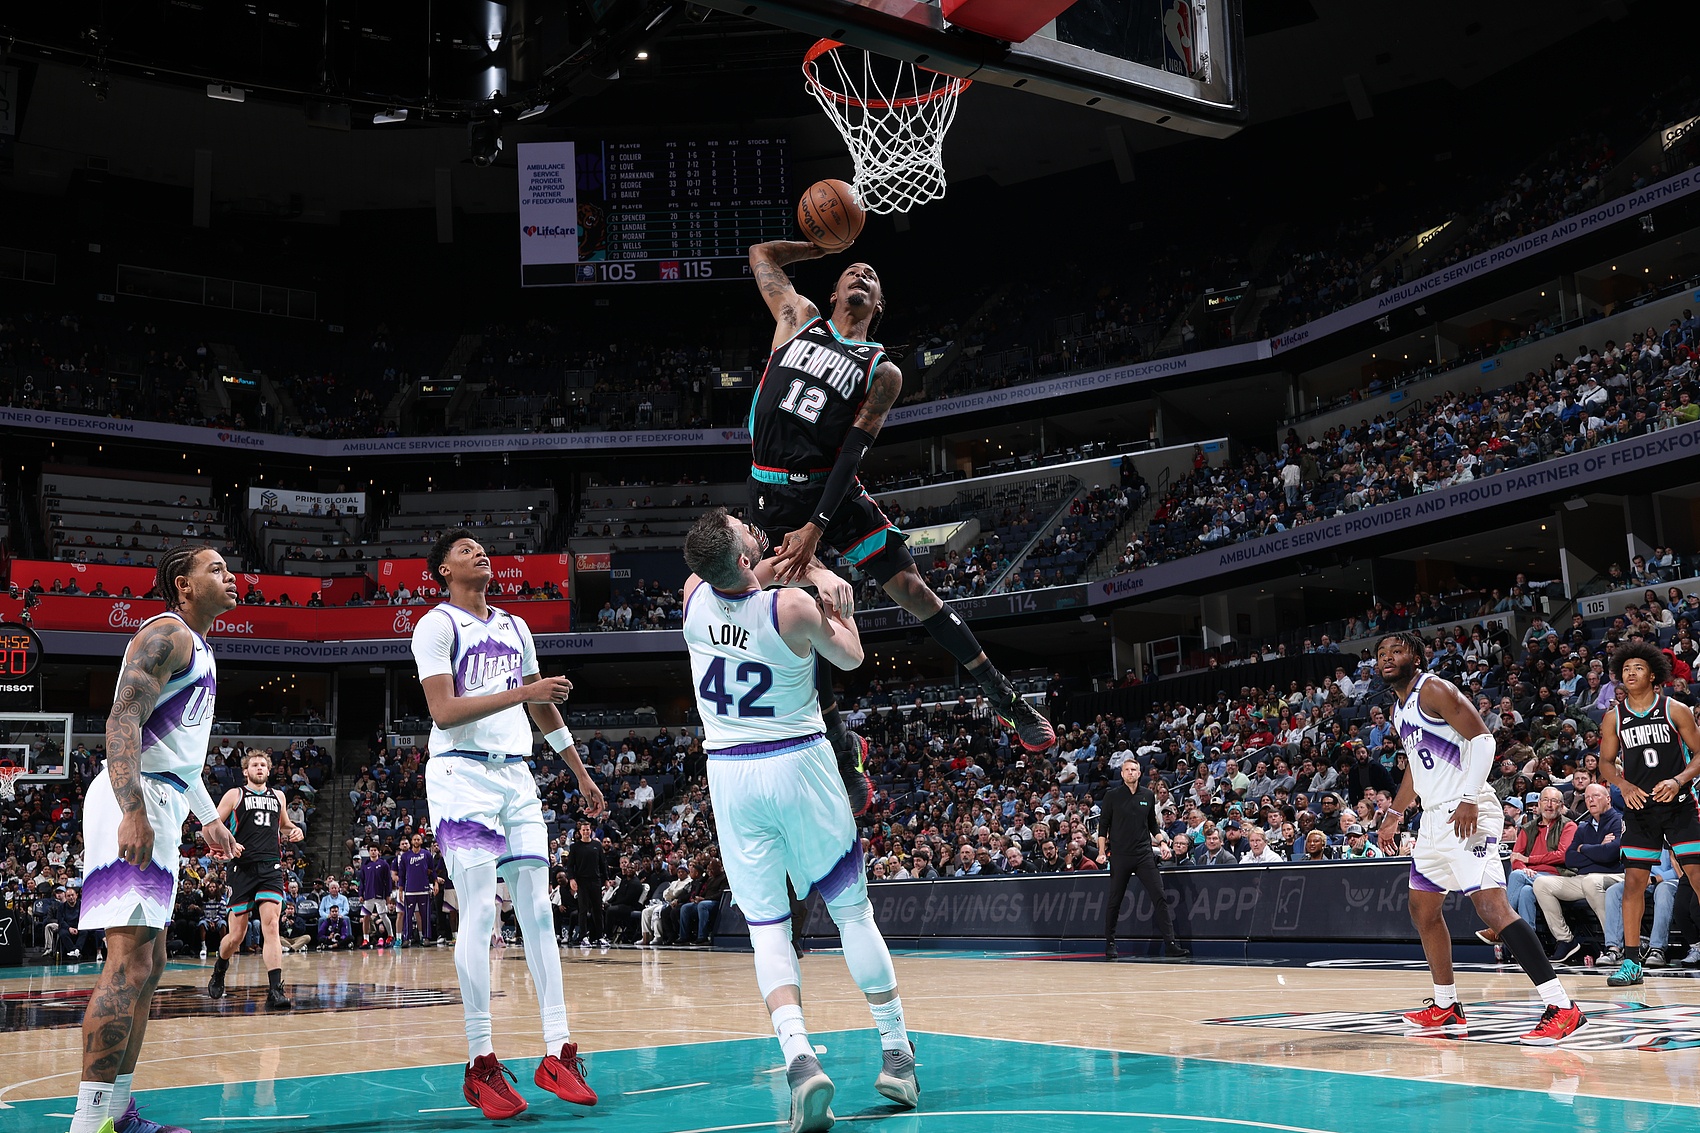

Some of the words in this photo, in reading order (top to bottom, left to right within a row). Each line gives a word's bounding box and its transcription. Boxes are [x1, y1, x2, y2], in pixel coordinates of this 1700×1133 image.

[1169, 58, 1183, 74] NBA
[802, 196, 825, 239] Wilson
[537, 226, 575, 238] LifeCare
[1379, 278, 1441, 308] AMBULANCE
[1444, 256, 1488, 282] SERVICE
[1491, 234, 1548, 264] PROVIDER
[1552, 223, 1578, 240] AND
[1581, 203, 1625, 228] PROUD
[1629, 178, 1689, 209] PARTNER
[600, 264, 636, 281] 105
[684, 261, 713, 278] 115
[1280, 329, 1309, 347] LifeCare
[779, 338, 864, 400] MEMPHIS
[895, 406, 933, 420] SERVICE
[936, 397, 984, 415] PROVIDER
[986, 392, 1008, 404] AND
[1010, 386, 1046, 399] PROUD
[1048, 378, 1095, 393] PARTNER
[1097, 373, 1112, 383] OF
[1114, 360, 1187, 381] FEDEXFORUM
[779, 378, 828, 424] 12
[0, 412, 32, 422] TNER
[35, 415, 52, 424] OF
[55, 417, 134, 433] FEDEXFORUM
[229, 434, 264, 447] LifeCare
[342, 442, 406, 451] AMBULANCE
[408, 440, 451, 449] SERVICE
[453, 439, 504, 448] PROVIDER
[506, 437, 529, 446] AND
[532, 436, 568, 445] PROUD
[570, 435, 616, 445] PARTNER
[619, 434, 633, 443] OF
[636, 433, 704, 442] FEDEXFORUM
[1219, 540, 1289, 566] AMBULANCE
[1292, 525, 1341, 547] SERVICE
[1345, 508, 1411, 534] PROVIDER
[1415, 498, 1446, 517] AND
[1449, 483, 1502, 507] PROUD
[1507, 463, 1580, 492] PARTNER
[1584, 452, 1606, 471] OF
[498, 568, 522, 578] with
[507, 583, 522, 594] Ap
[1114, 578, 1144, 595] LifeCare
[982, 599, 987, 607] 3
[1007, 593, 1037, 613] 114
[1587, 601, 1605, 613] 105
[858, 616, 872, 628] 4TH
[874, 617, 887, 627] QTR
[897, 609, 922, 626] 4:5
[0, 636, 30, 649] 4:52
[537, 638, 593, 649] EXFORUM
[708, 624, 750, 650] LOVE
[226, 644, 280, 655] SERVICE
[284, 646, 348, 656] PROVIDER
[352, 645, 378, 655] AND
[382, 645, 412, 654] PRO
[465, 652, 521, 691] UTAH
[0, 684, 34, 692] TISSOT
[699, 656, 775, 718] 42
[1402, 727, 1423, 751] TAH
[1621, 724, 1670, 749] MEMPHIS
[1418, 748, 1434, 770] 8
[1643, 748, 1659, 768] 0
[245, 796, 279, 811] MEMPHIS
[254, 812, 271, 826] 31
[1378, 872, 1464, 911] Krer
[879, 896, 916, 923] BIG
[921, 893, 1025, 922] SAVINGS
[1032, 891, 1104, 922] WITH
[1188, 886, 1259, 921] APP
